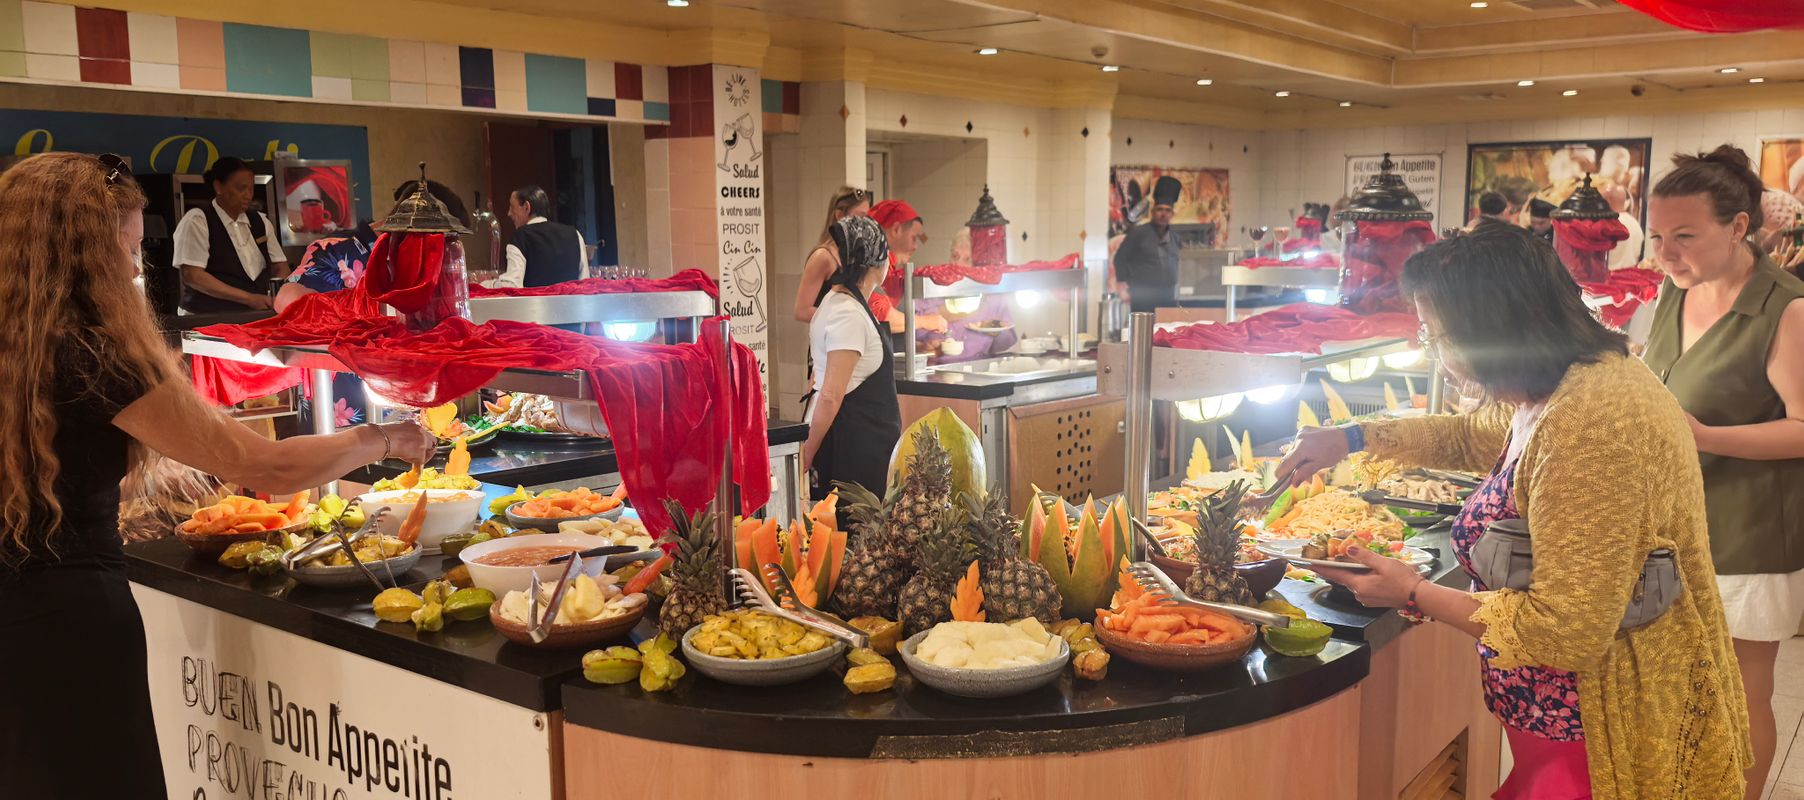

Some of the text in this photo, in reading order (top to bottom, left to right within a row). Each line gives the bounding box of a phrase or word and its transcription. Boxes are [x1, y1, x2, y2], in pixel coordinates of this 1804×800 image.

[733, 163, 759, 178] Salud
[721, 186, 760, 199] CHEERS
[720, 205, 761, 217] à votre santé
[722, 223, 760, 235] PROSIT
[723, 240, 761, 255] Cin Cin
[723, 301, 754, 317] Salud
[729, 325, 754, 335] ROSIT
[181, 655, 262, 734] BUEN
[267, 680, 320, 762] Bon
